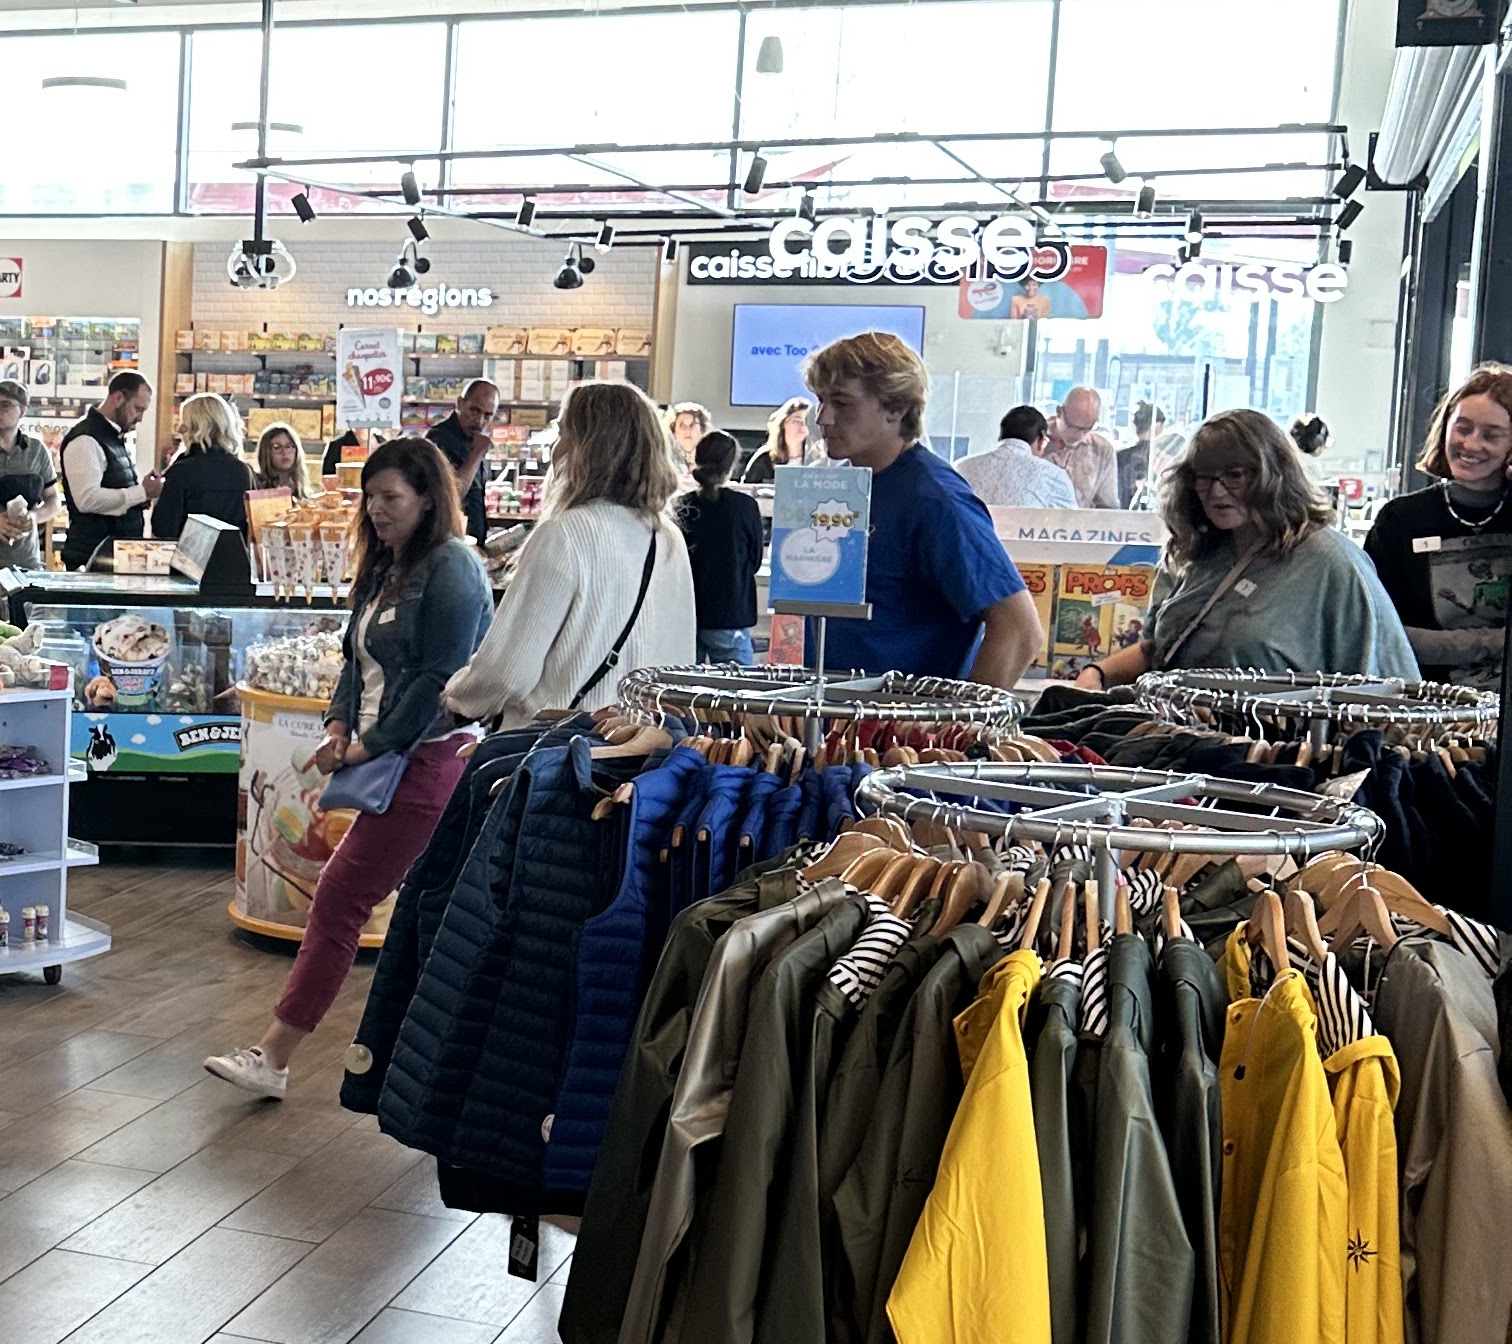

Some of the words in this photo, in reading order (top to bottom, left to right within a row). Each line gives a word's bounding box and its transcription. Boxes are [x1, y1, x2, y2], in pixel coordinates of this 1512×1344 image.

[769, 202, 1036, 269] caisse
[1141, 260, 1348, 303] caisse
[346, 287, 392, 307] nos
[394, 283, 493, 315] régions
[751, 346, 782, 356] avec
[784, 344, 808, 357] Too
[794, 479, 809, 489] LA
[813, 480, 848, 490] MODE
[1018, 527, 1153, 543] MAGAZINES
[1065, 571, 1149, 597] PROFS
[290, 720, 316, 731] CURE
[179, 726, 242, 747] BEN&JE
